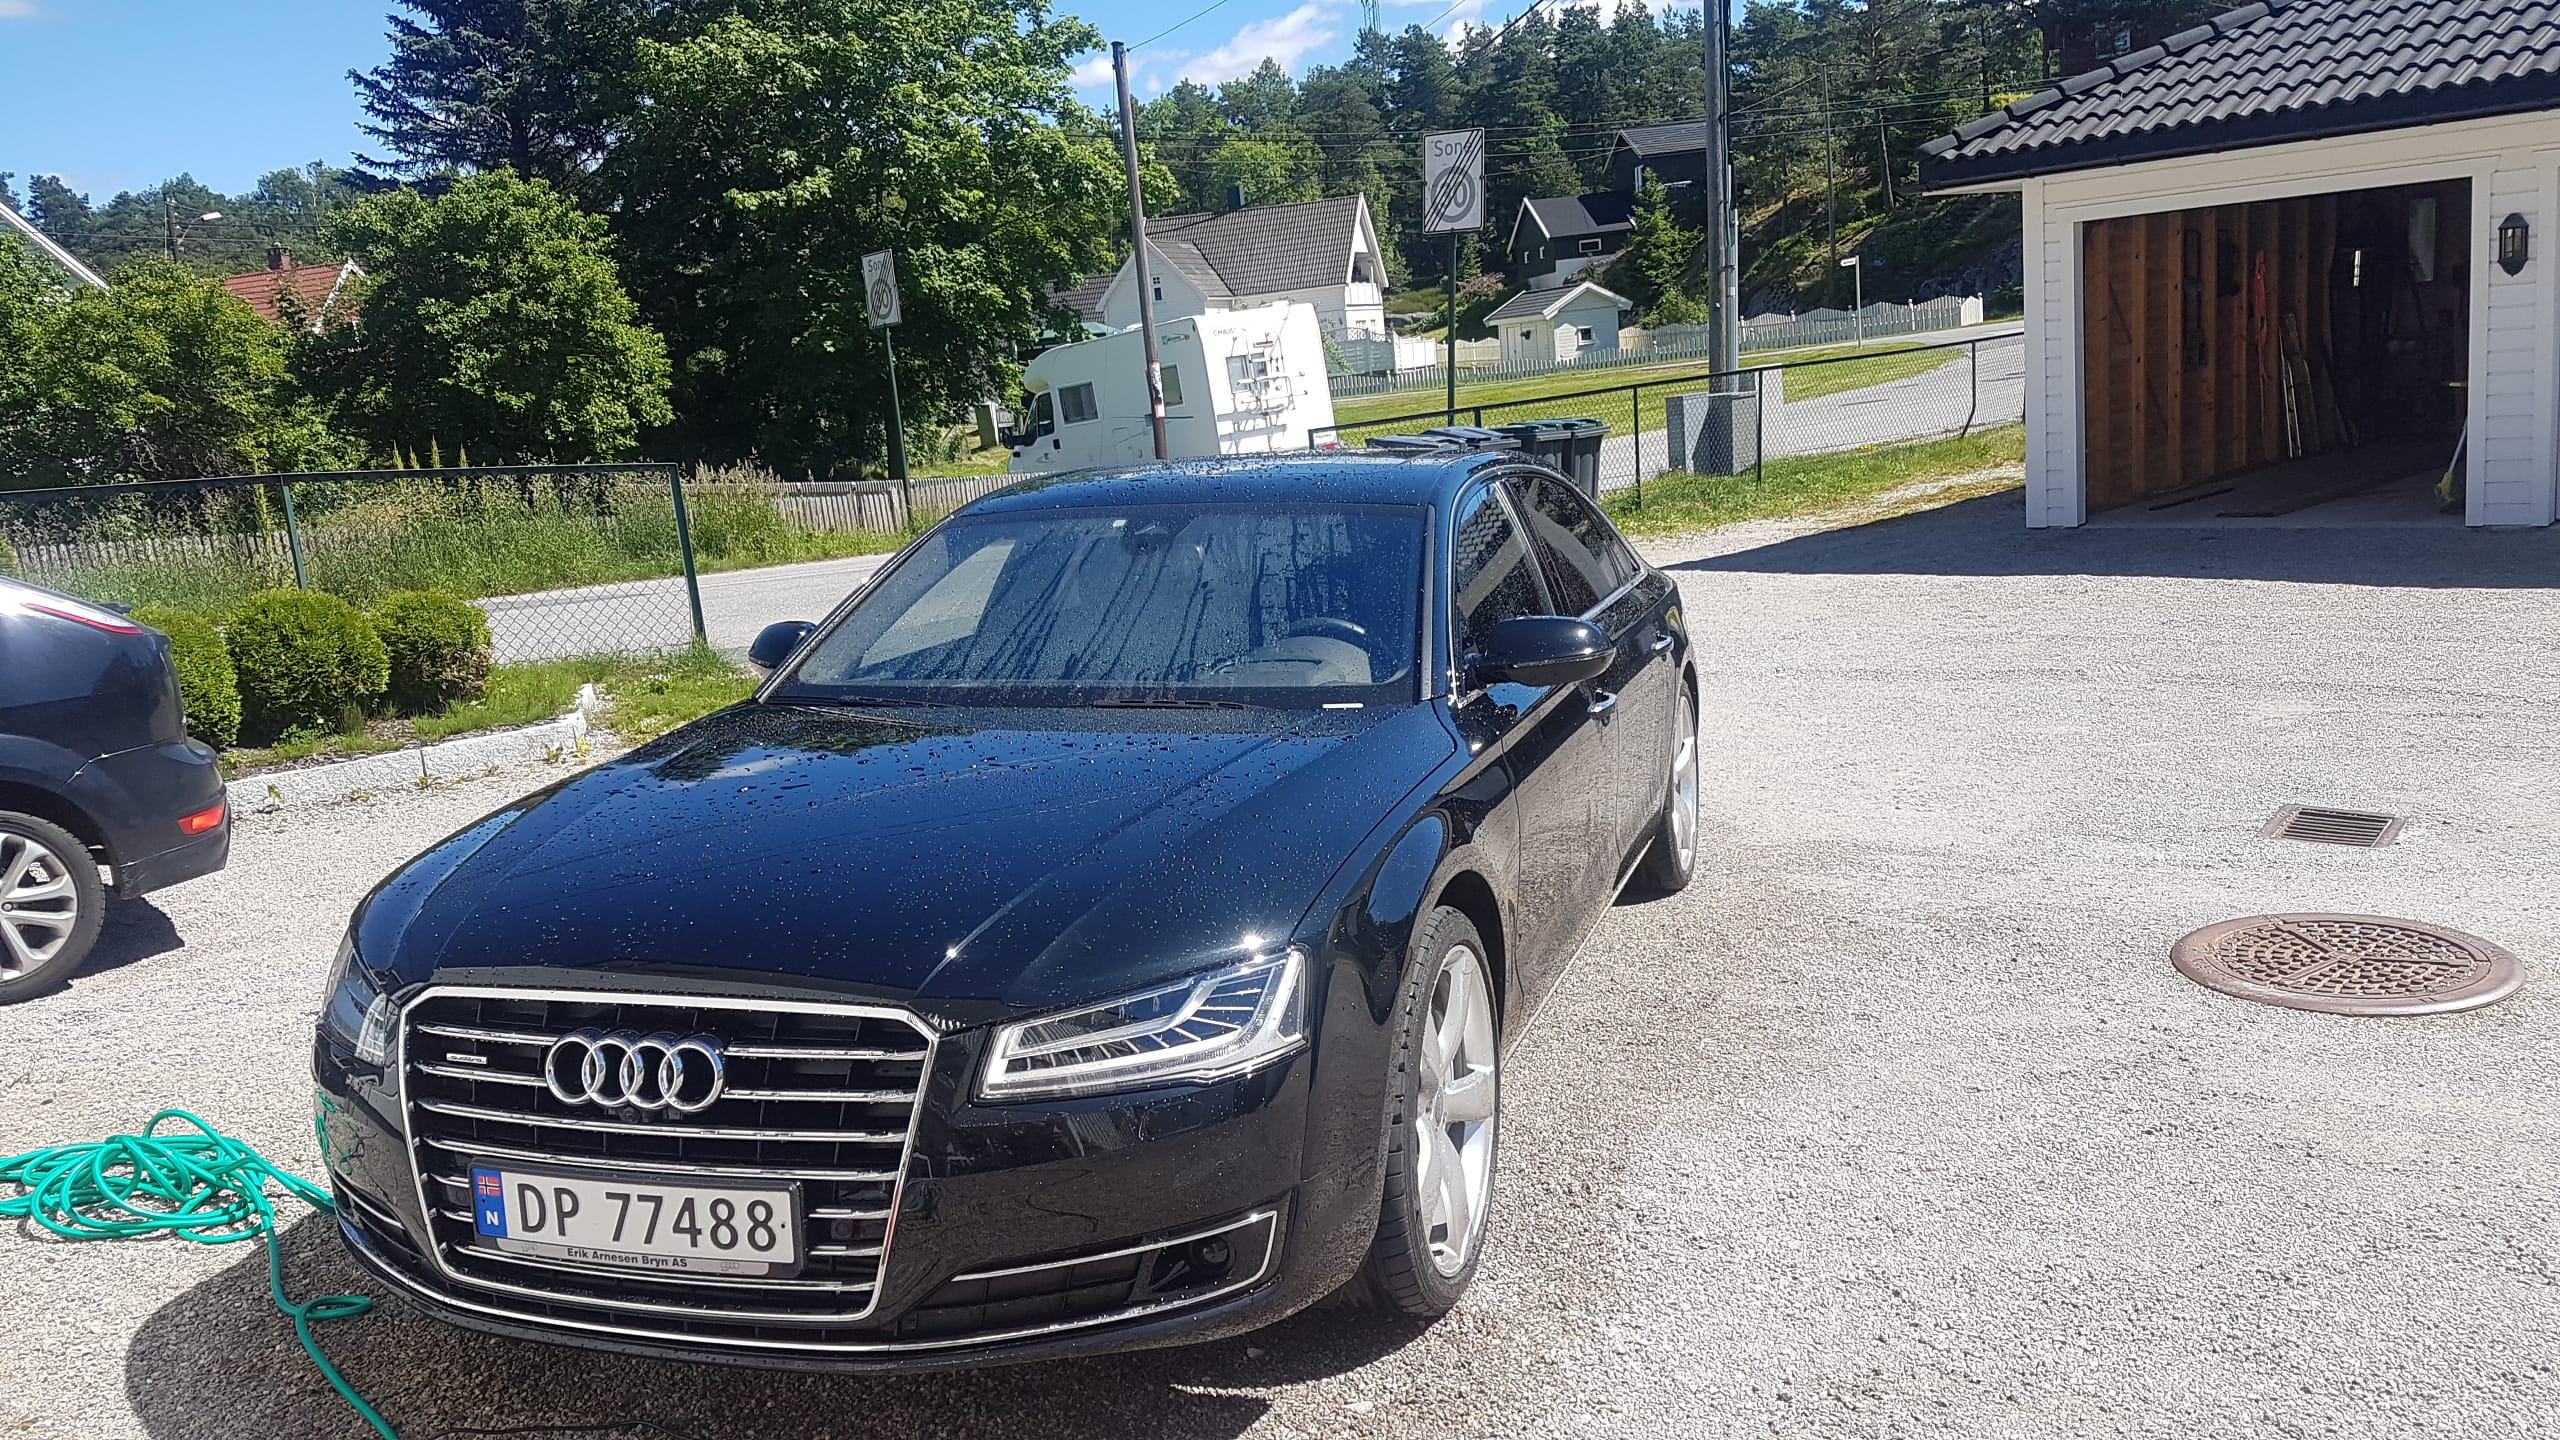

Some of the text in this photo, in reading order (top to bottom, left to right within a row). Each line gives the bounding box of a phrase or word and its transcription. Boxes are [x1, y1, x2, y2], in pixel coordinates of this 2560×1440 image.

[868, 259, 887, 273] Son
[486, 1210, 499, 1226] N
[517, 1183, 776, 1252] DP 77488
[567, 1248, 687, 1268] Erik Arnesen Bryn AS
